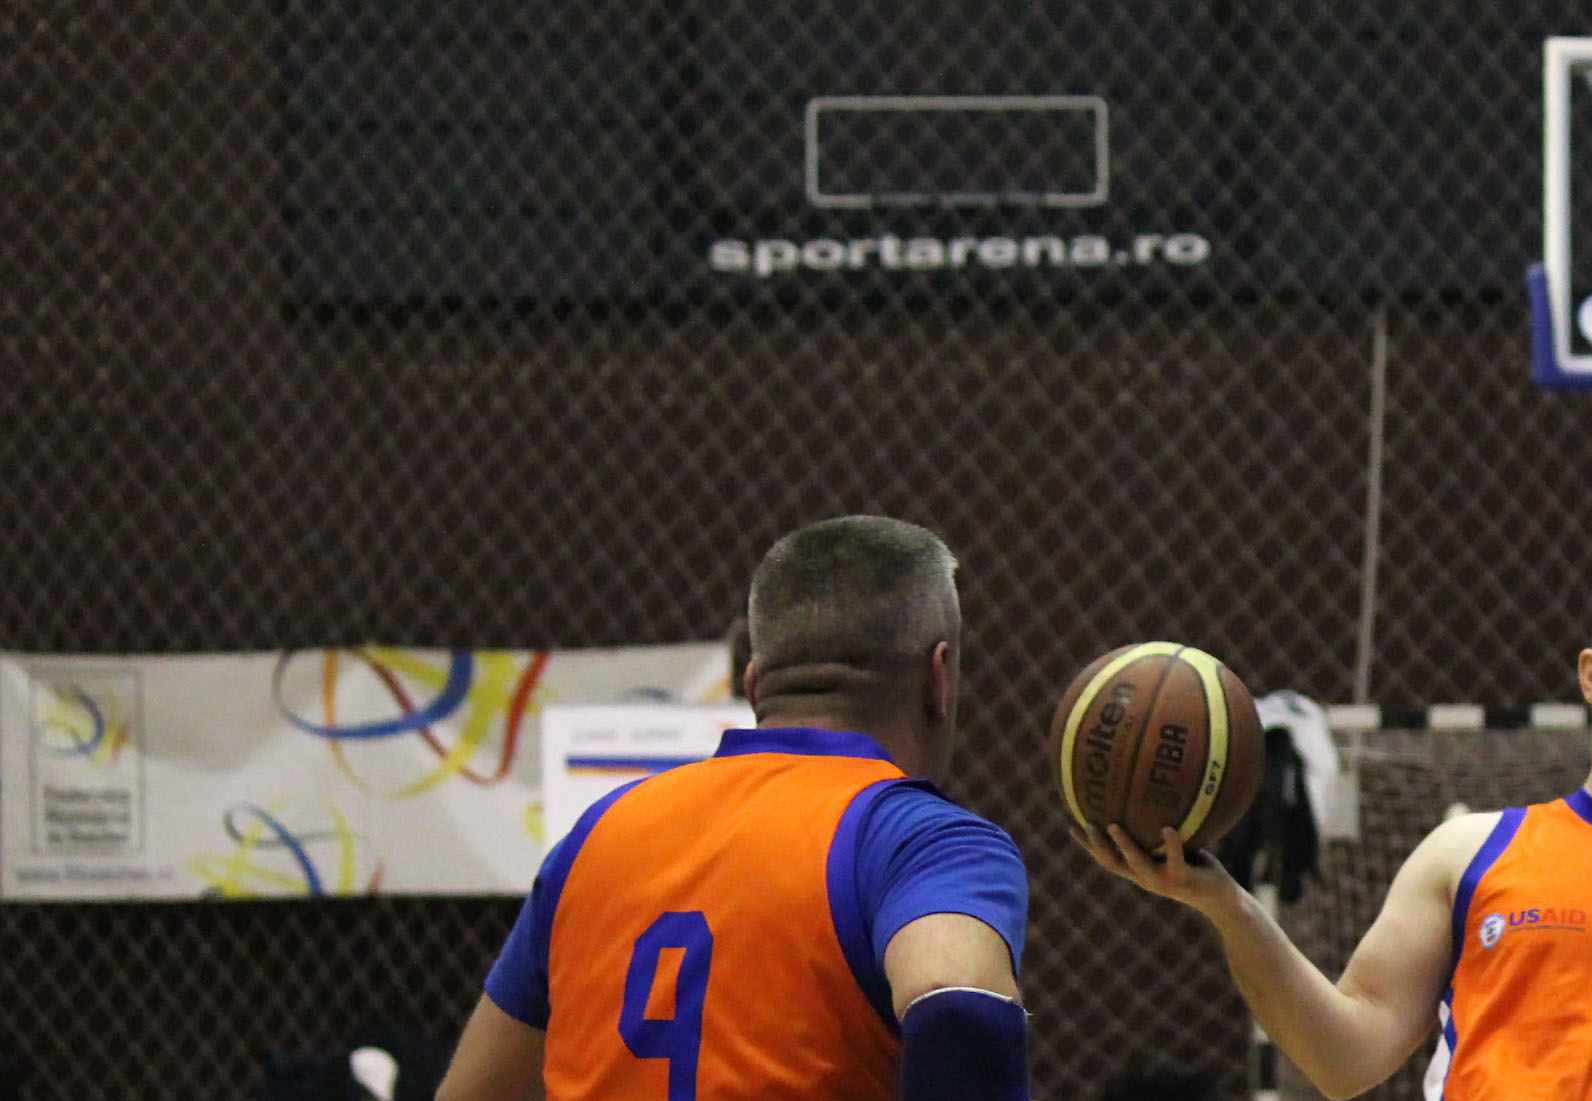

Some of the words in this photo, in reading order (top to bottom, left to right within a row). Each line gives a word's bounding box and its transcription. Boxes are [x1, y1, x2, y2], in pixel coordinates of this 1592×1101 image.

[710, 232, 1210, 276] sportarena.ro
[1084, 681, 1137, 816] molten
[1149, 724, 1188, 786] FIBA
[1509, 908, 1586, 927] USAID
